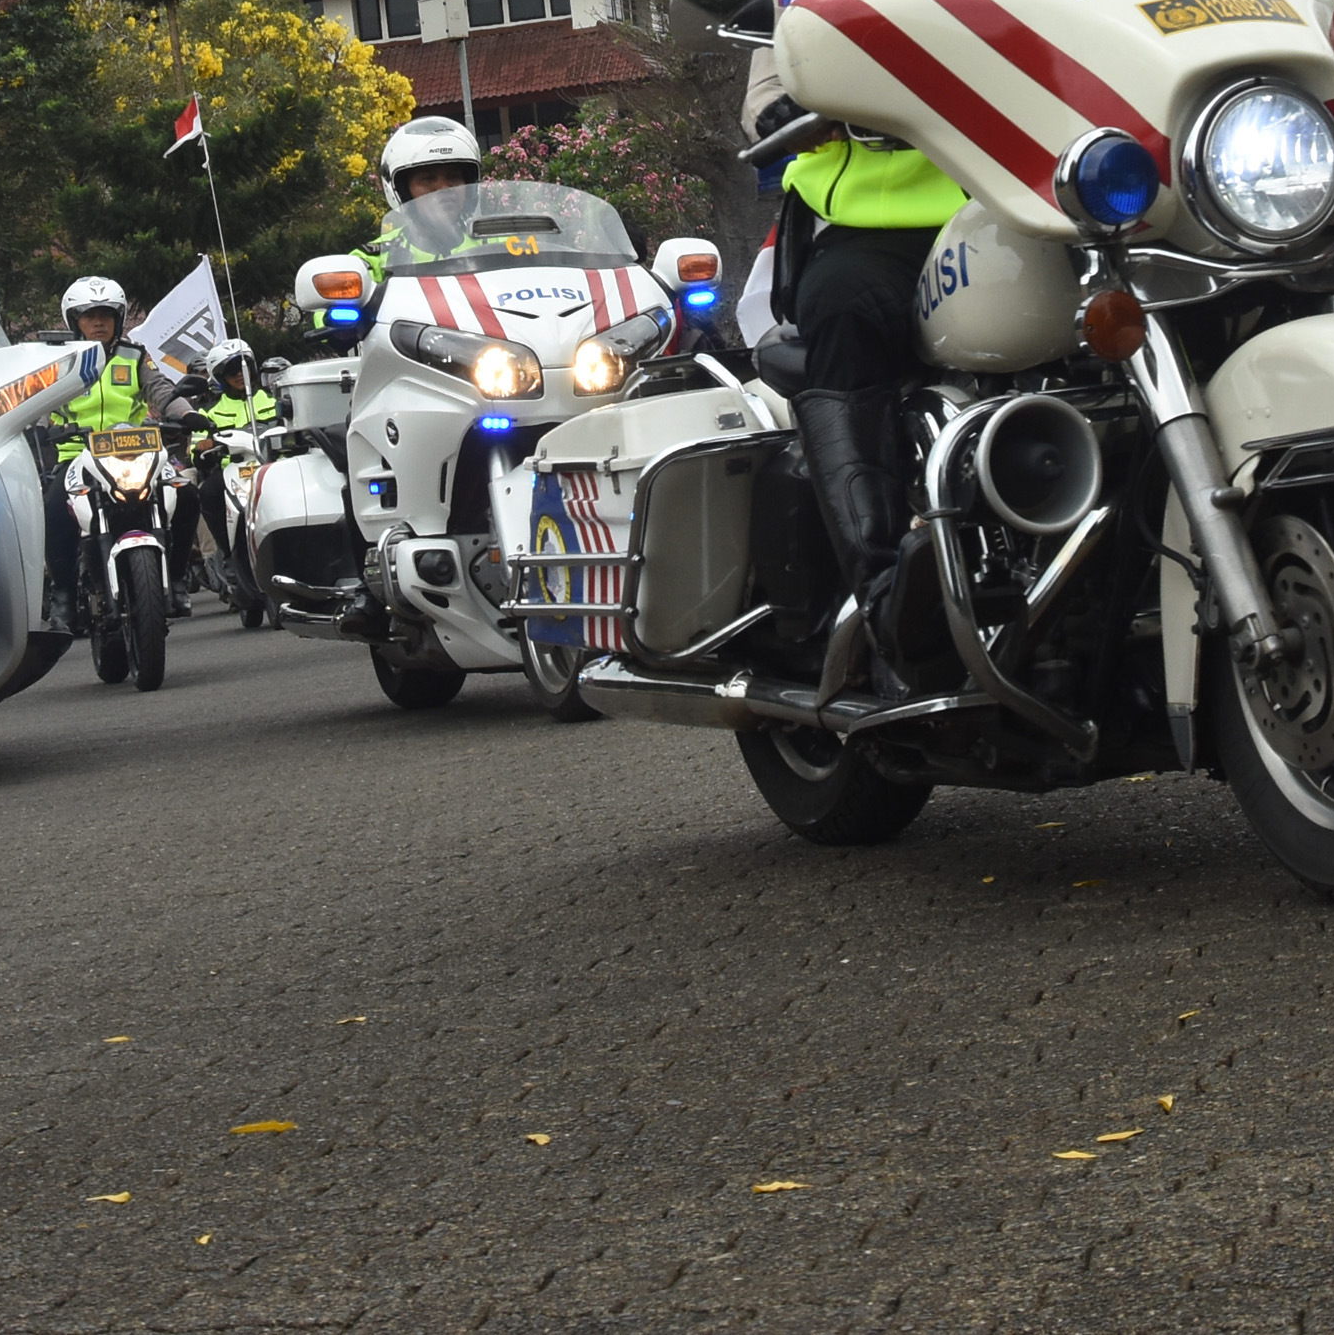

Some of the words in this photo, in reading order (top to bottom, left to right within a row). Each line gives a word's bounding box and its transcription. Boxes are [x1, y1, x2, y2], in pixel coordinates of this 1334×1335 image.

[505, 235, 540, 256] C.1
[916, 241, 970, 321] OLISI
[497, 287, 586, 307] POLISI
